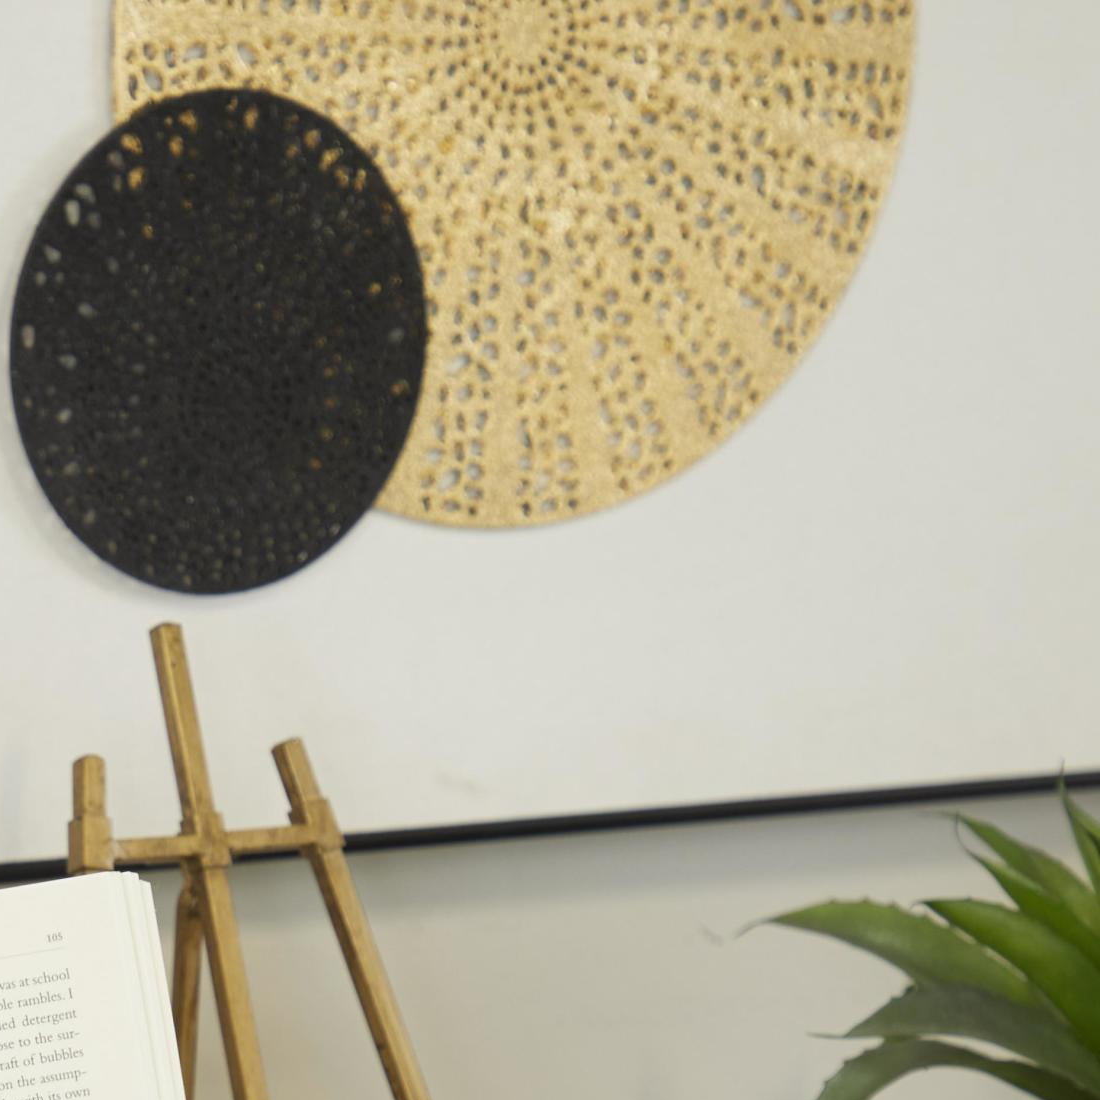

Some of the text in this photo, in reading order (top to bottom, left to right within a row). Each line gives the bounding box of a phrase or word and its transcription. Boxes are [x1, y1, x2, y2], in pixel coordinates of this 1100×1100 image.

[47, 931, 63, 943] 105
[19, 977, 31, 988] at
[31, 967, 71, 986] school
[17, 990, 66, 1009] rambles.
[21, 1009, 77, 1028] detergent
[17, 1037, 32, 1048] to
[34, 1031, 54, 1045] the
[56, 1030, 80, 1041] sur-
